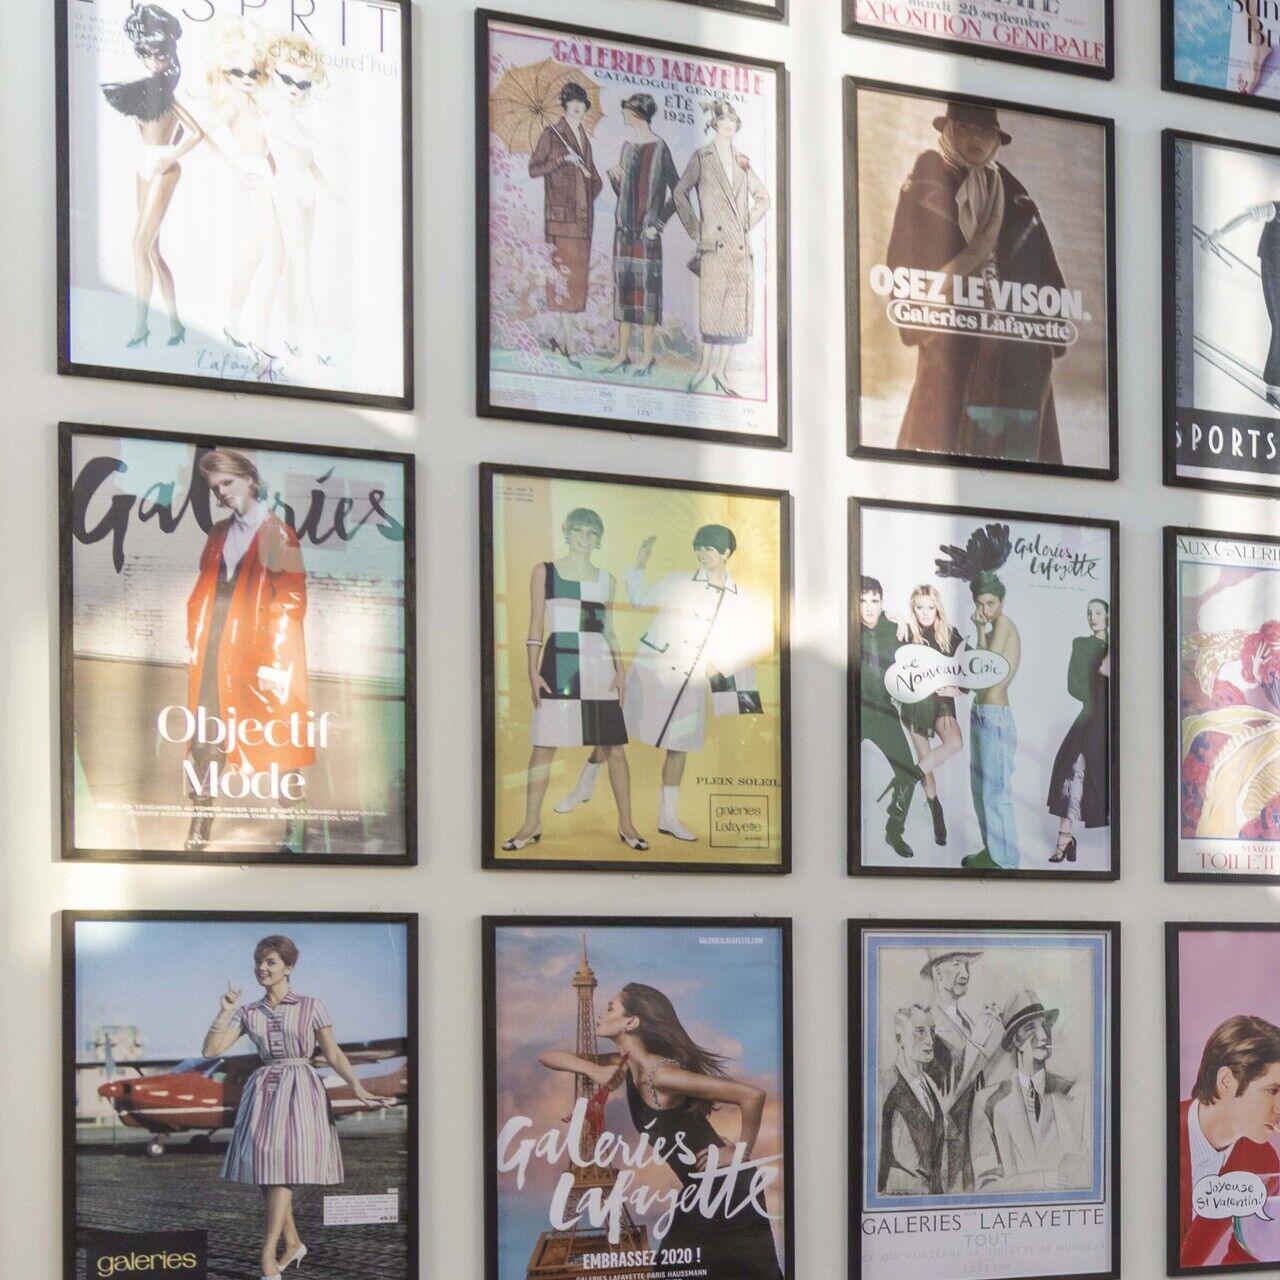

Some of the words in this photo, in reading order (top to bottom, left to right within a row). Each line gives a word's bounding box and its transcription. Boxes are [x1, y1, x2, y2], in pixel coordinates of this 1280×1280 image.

[980, 9, 1050, 31] septembre
[553, 38, 655, 78] GALERIES
[661, 56, 764, 96] LAFAYETTE
[593, 69, 680, 92] CATALOGUE
[662, 109, 695, 125] 1925
[869, 263, 947, 304] OSEZ
[952, 274, 985, 308] LE
[989, 279, 1093, 322] VISON.
[894, 302, 978, 330] Galeries
[979, 311, 1071, 341] Lafayette
[72, 446, 405, 574] Galries
[1014, 533, 1073, 561] Galeries
[1176, 537, 1211, 556] AUX
[1028, 552, 1103, 581] Lafayette
[896, 663, 967, 693] Nouveau
[968, 656, 1002, 677] Chic
[157, 704, 341, 754] Objectif
[697, 777, 732, 786] PLEIN
[715, 804, 762, 818] galeries
[714, 820, 762, 836] Lafayette
[498, 1097, 697, 1190] Galeries
[549, 1141, 783, 1244] Lafayette
[1196, 1196, 1210, 1209] St
[1212, 1193, 1264, 1210] Valentin!
[1205, 1181, 1255, 1197] Joyeuse
[862, 1214, 962, 1236] GALERIES
[980, 1208, 1105, 1230] LAFAYETTE
[962, 1232, 1011, 1248] TOUT
[96, 1251, 198, 1278] galeries
[583, 1251, 657, 1270] EMBRASSEZ
[661, 1248, 693, 1267] 2020
[696, 1247, 702, 1264] !
[647, 1270, 667, 1280] PARIS
[668, 1268, 708, 1278] HAUSSMANN
